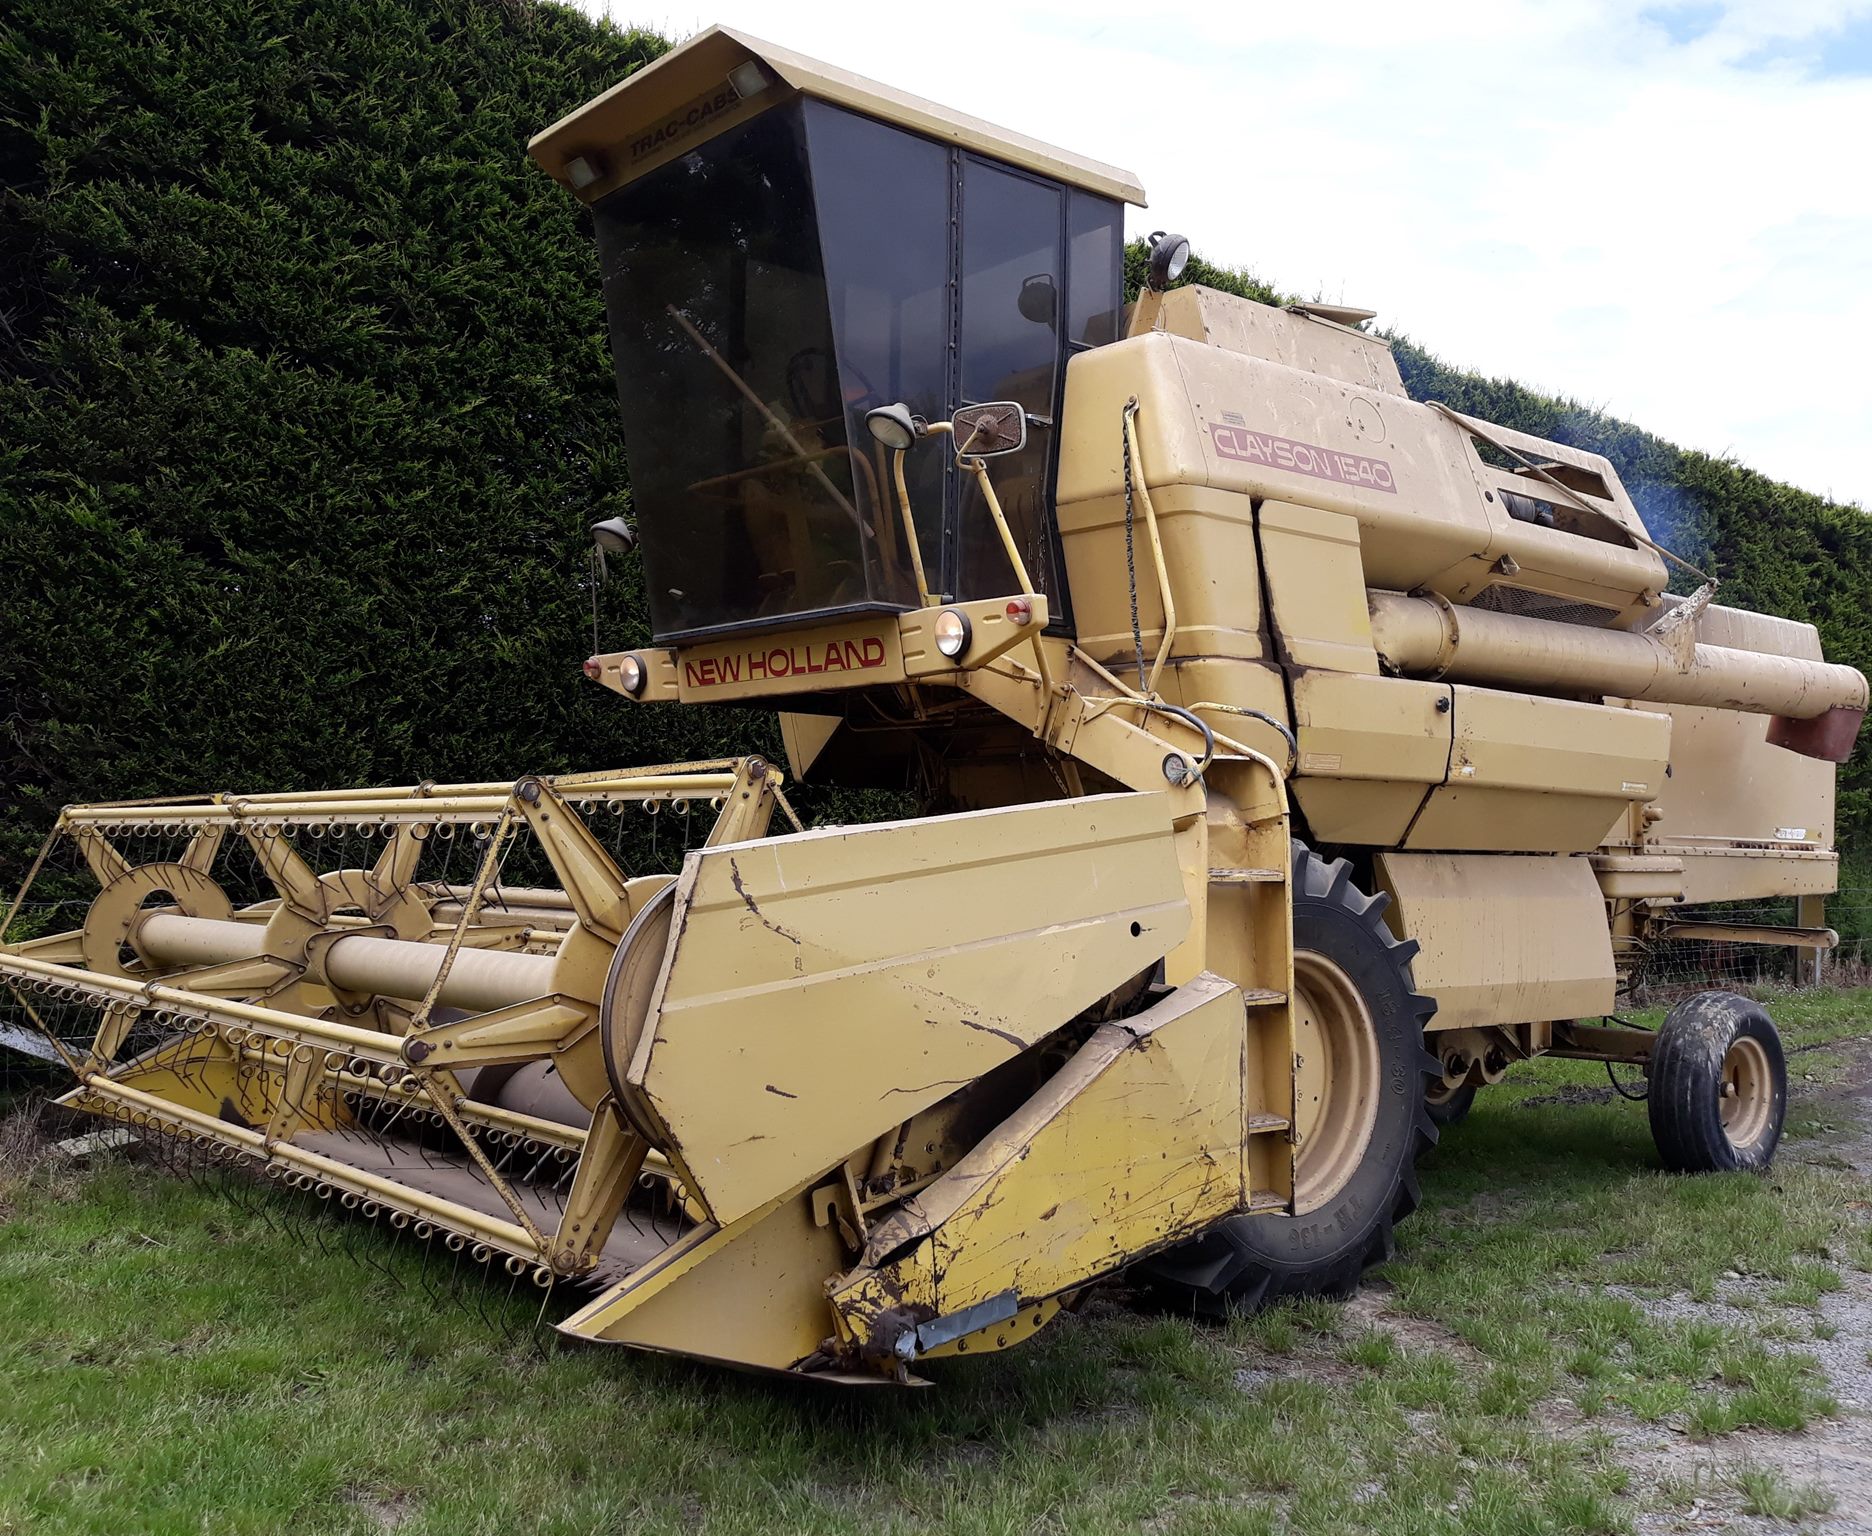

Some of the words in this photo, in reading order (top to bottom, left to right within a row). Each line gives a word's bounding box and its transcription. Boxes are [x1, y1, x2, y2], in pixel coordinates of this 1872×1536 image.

[1214, 428, 1332, 476] CLAYSON
[1334, 455, 1393, 487] 1540
[685, 655, 741, 687] NEW
[748, 637, 885, 680] HOLLAND
